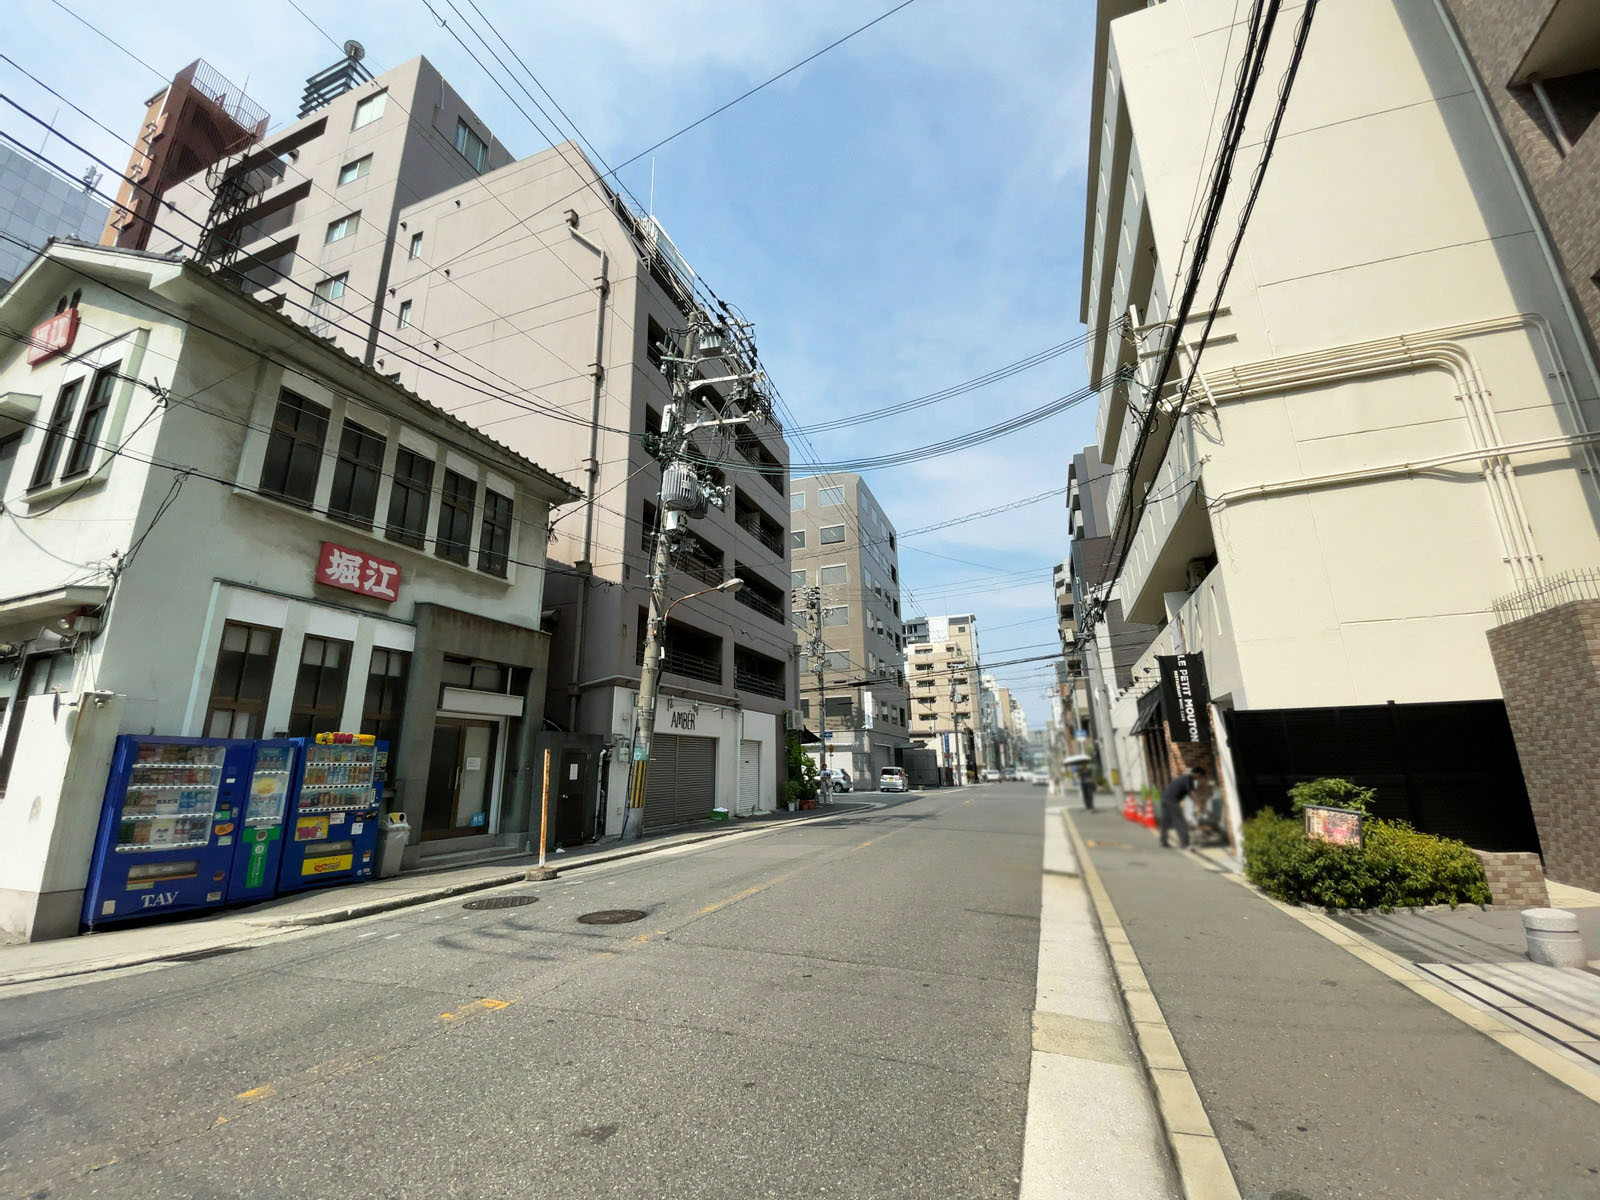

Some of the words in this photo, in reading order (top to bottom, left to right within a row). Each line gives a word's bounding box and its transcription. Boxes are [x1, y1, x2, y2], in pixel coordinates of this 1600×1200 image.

[325, 548, 398, 597] 堀江
[1177, 655, 1187, 667] LE
[1179, 669, 1192, 696] PETIT
[1184, 698, 1200, 743] MOUTON
